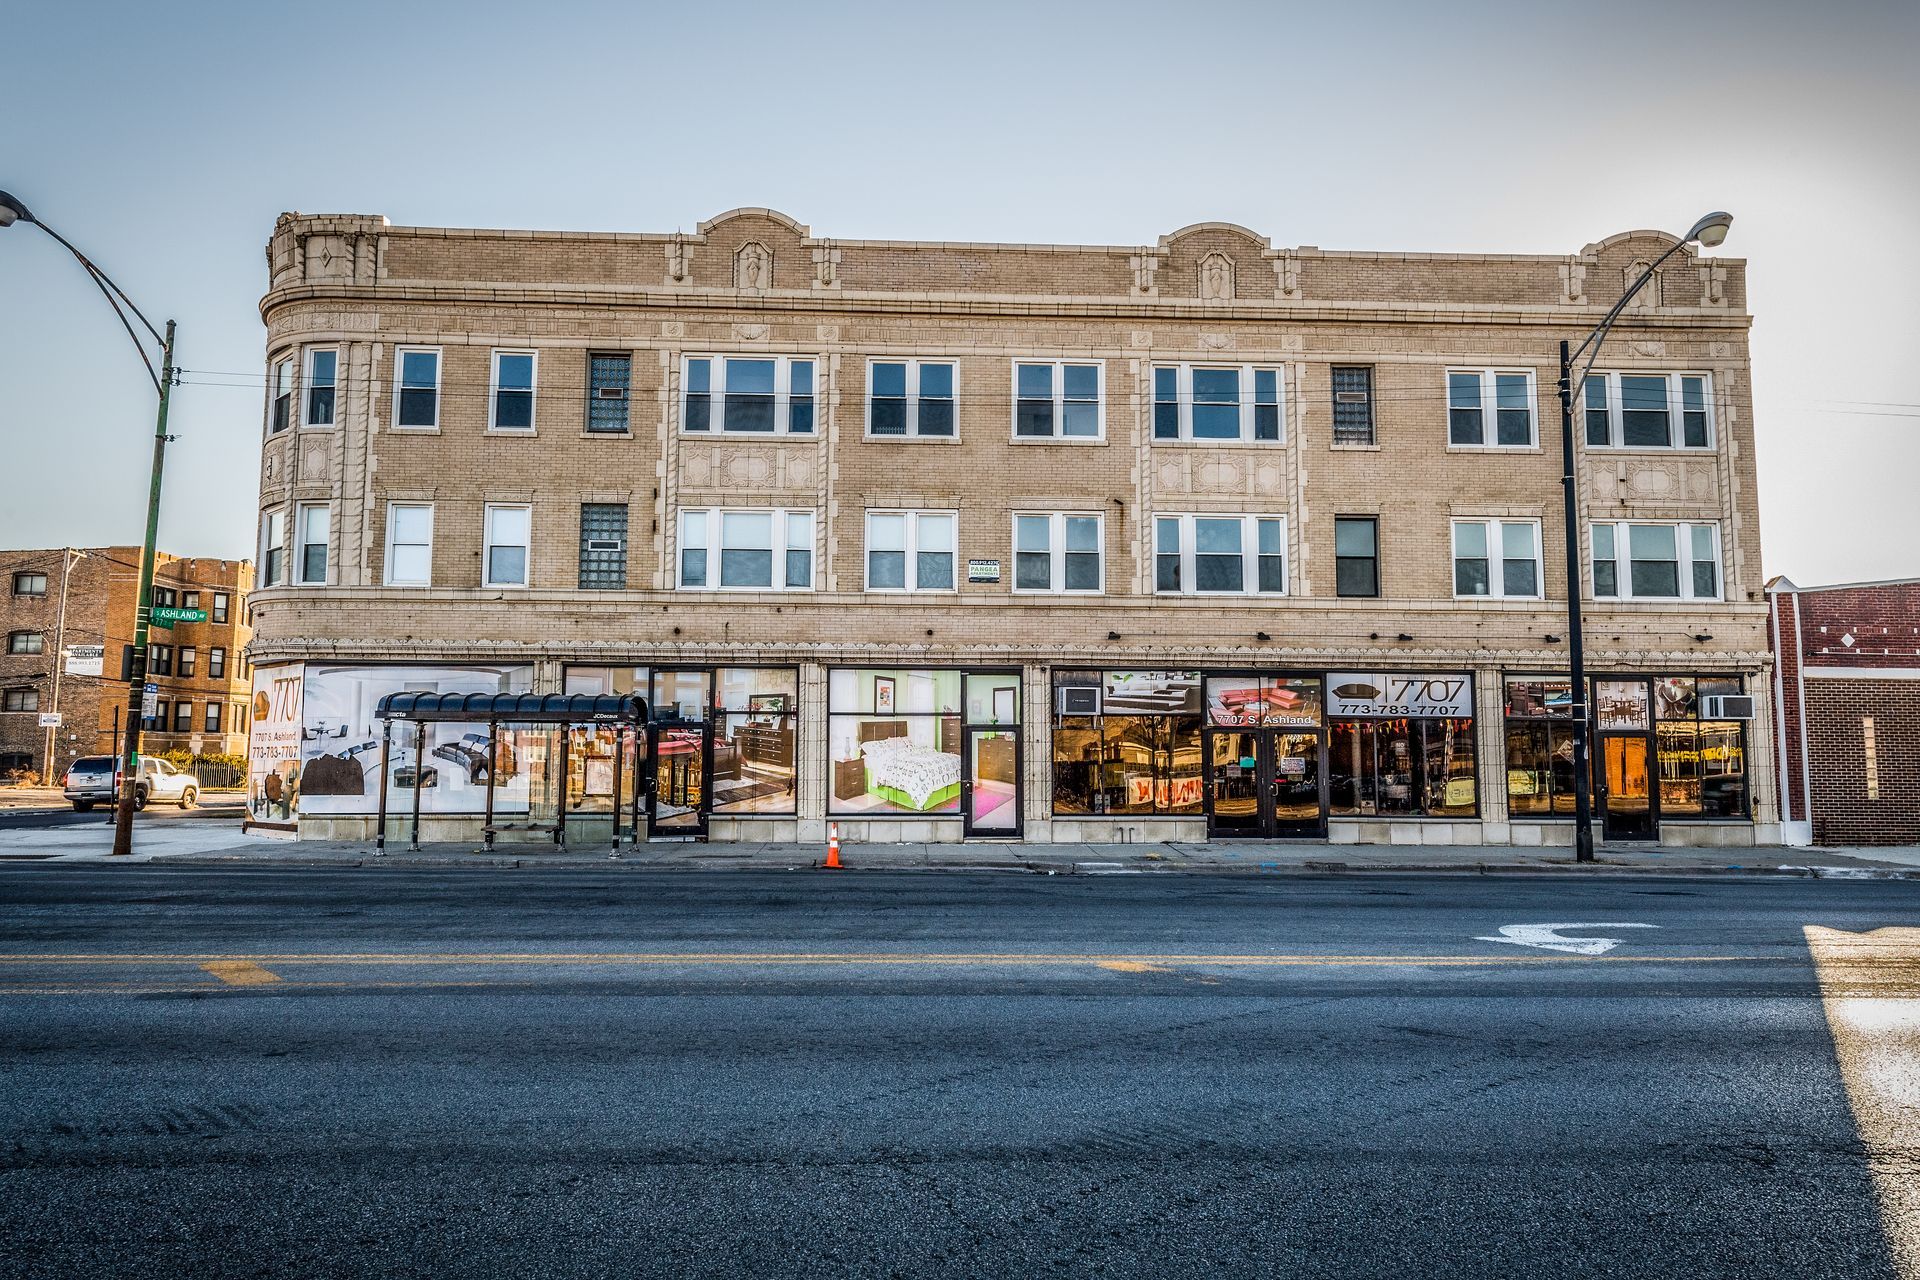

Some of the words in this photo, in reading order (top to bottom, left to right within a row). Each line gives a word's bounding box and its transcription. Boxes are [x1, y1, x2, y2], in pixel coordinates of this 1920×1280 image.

[160, 609, 198, 620] ASHLAND
[1391, 679, 1465, 703] 7707
[274, 676, 301, 722] 7707
[1338, 704, 1460, 716] 773-783-7707
[1217, 715, 1244, 725] 7707
[1247, 715, 1260, 725] S.
[1263, 715, 1312, 725] Ashland
[273, 731, 297, 741] Ashland
[252, 745, 299, 759] 773-783-7707
